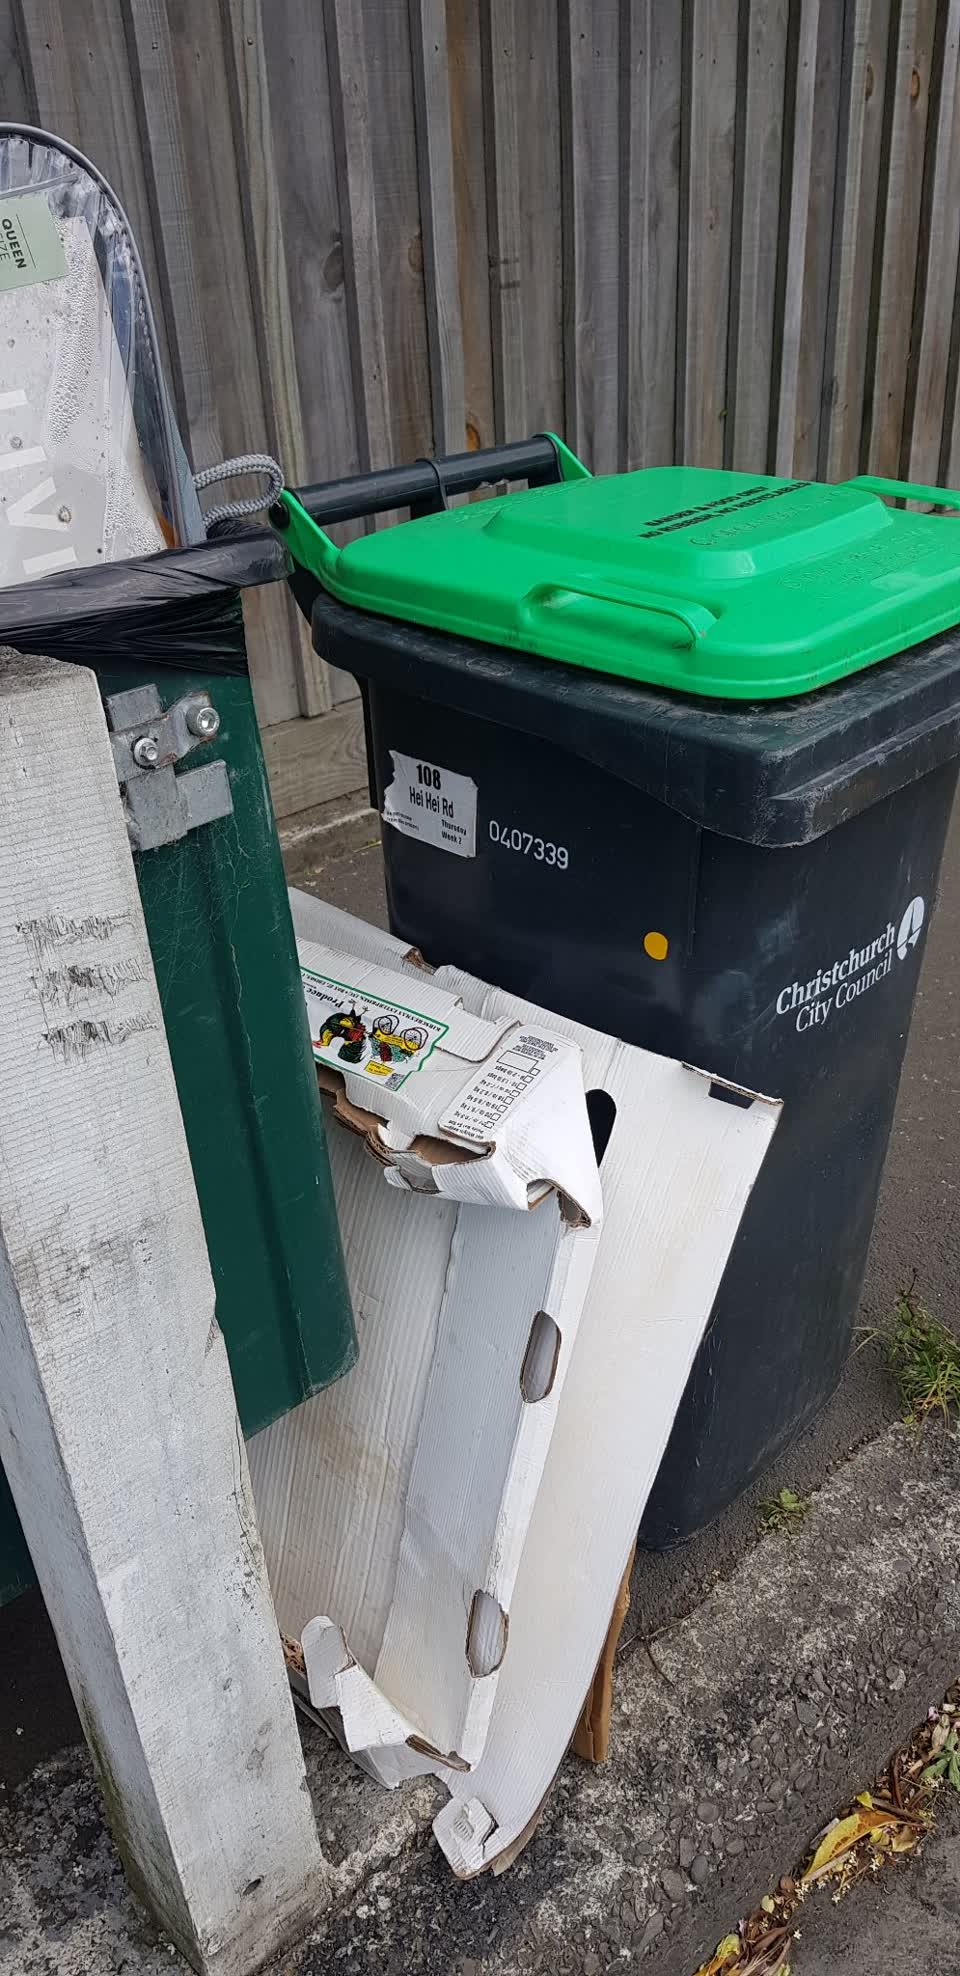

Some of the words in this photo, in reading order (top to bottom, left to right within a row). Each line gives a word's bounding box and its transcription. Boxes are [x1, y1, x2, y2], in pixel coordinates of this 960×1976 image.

[2, 218, 27, 270] QUEEN
[416, 763, 442, 791] 108
[409, 786, 424, 807] Hei
[425, 791, 440, 815] Hei
[442, 797, 454, 819] Rd
[441, 819, 467, 836] Thursday
[441, 831, 458, 845] Week
[489, 820, 569, 870] 0407339
[776, 922, 896, 1015] Christchurch
[306, 988, 344, 1008] Produce
[796, 997, 833, 1032] City
[835, 948, 893, 1009] Council
